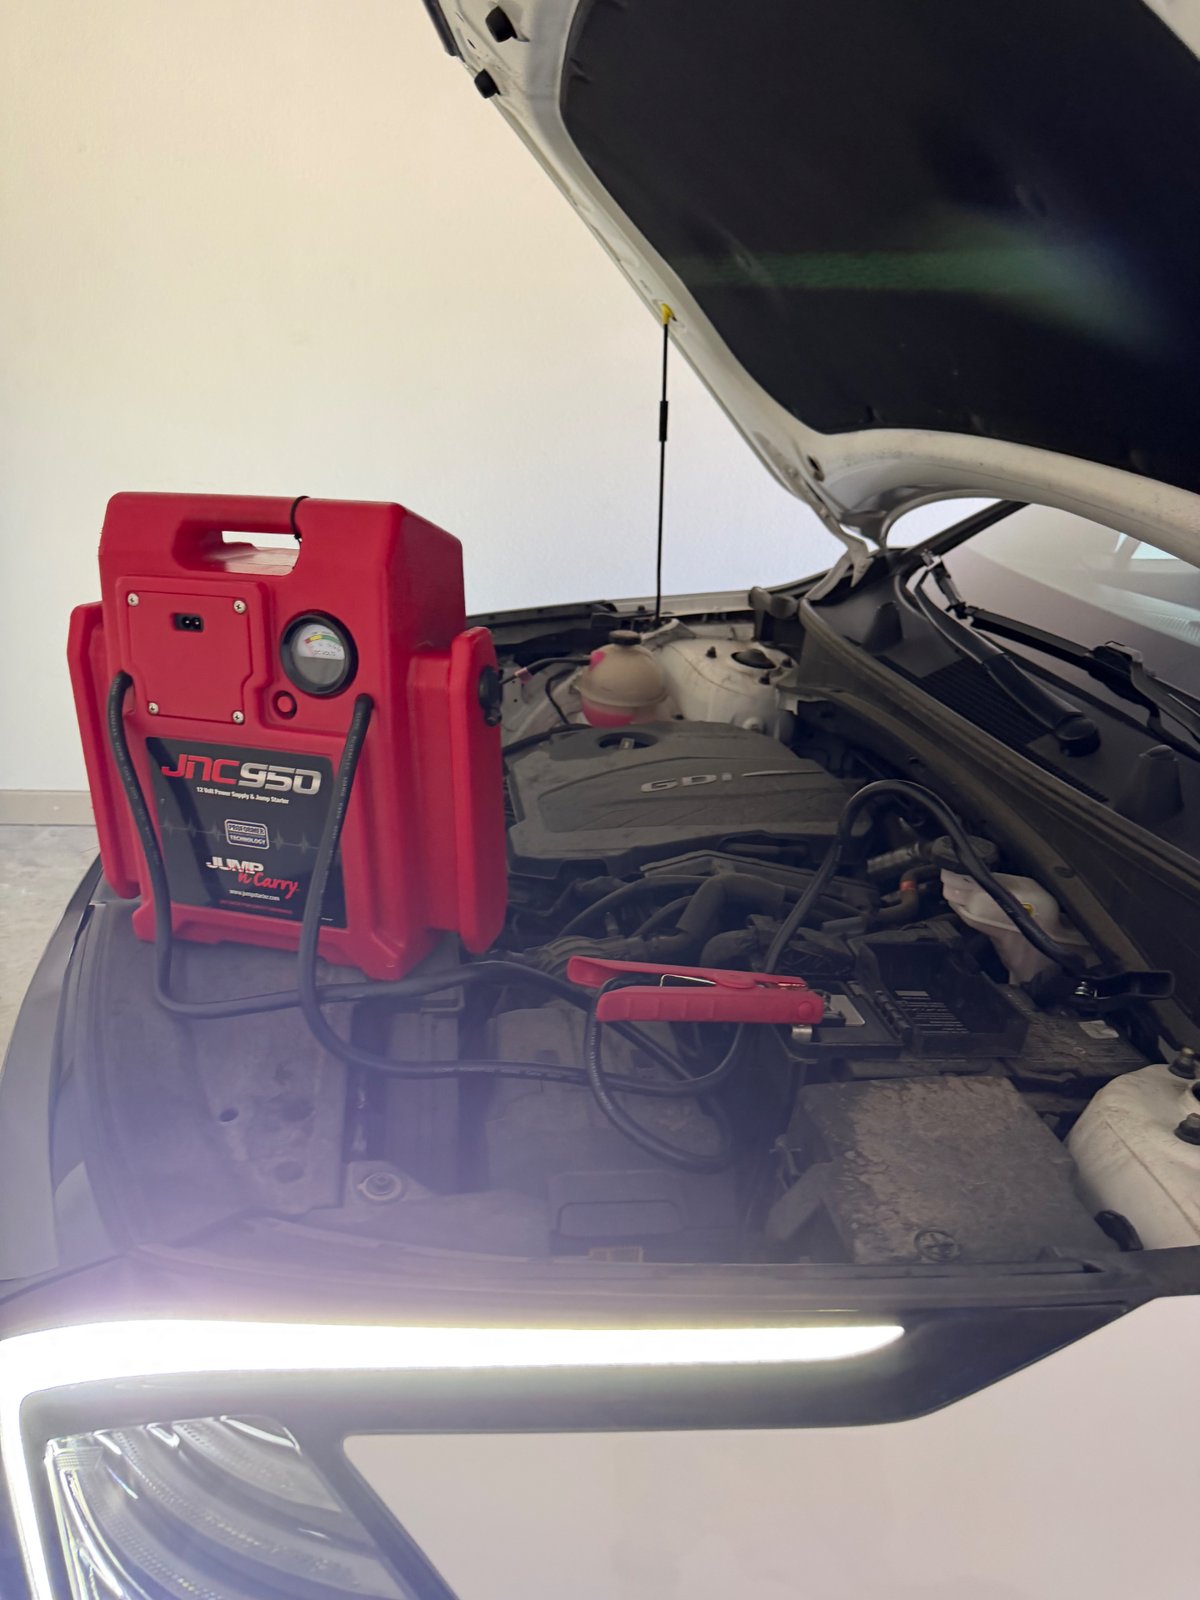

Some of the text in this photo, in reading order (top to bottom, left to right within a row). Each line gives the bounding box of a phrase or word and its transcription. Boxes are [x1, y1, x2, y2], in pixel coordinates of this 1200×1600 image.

[203, 787, 214, 795] Volt
[214, 788, 231, 797] Power
[231, 791, 250, 800] Supply
[255, 794, 271, 803] Jump
[270, 796, 290, 804] Starter
[230, 834, 266, 846] TECHNOLOGY
[206, 856, 264, 874] JUMP
[253, 872, 299, 900] Carry
